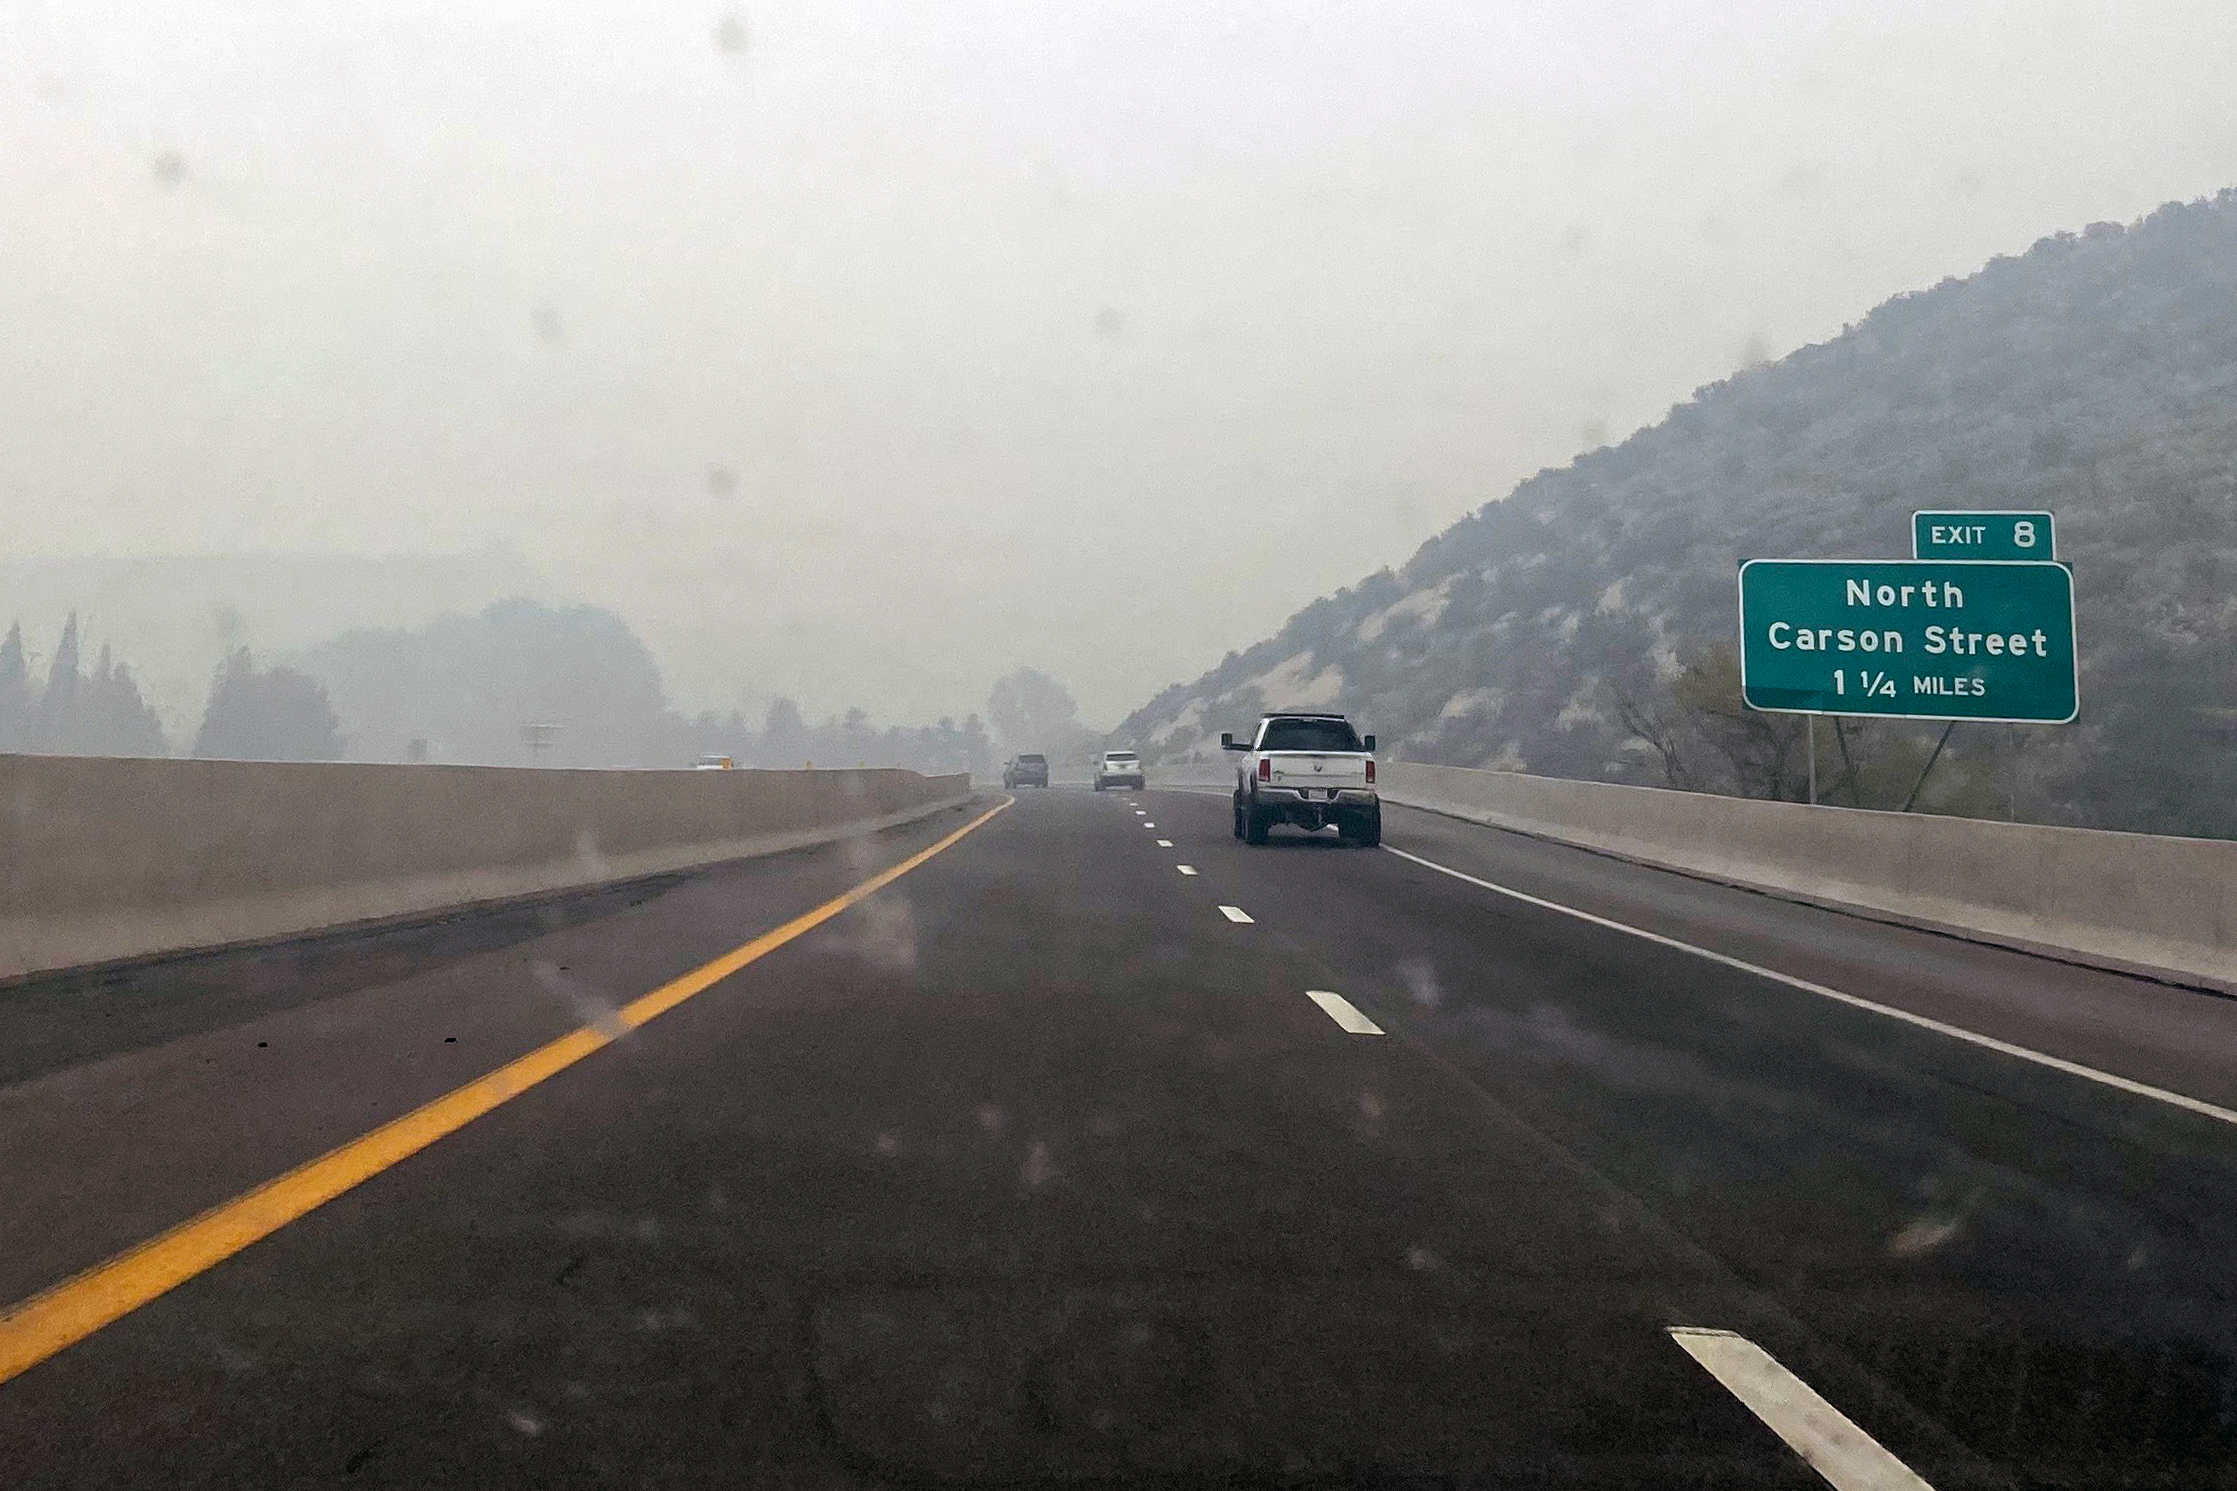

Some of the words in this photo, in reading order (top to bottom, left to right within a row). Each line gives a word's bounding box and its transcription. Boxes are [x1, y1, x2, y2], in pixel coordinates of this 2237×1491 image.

[1931, 525, 1986, 545] EXIT
[2013, 521, 2036, 548] 8
[1846, 579, 1964, 608] North
[1768, 621, 1903, 653] Carson
[1924, 625, 2047, 657] Street
[1833, 669, 1845, 695] 1
[1913, 675, 1986, 696] MILES
